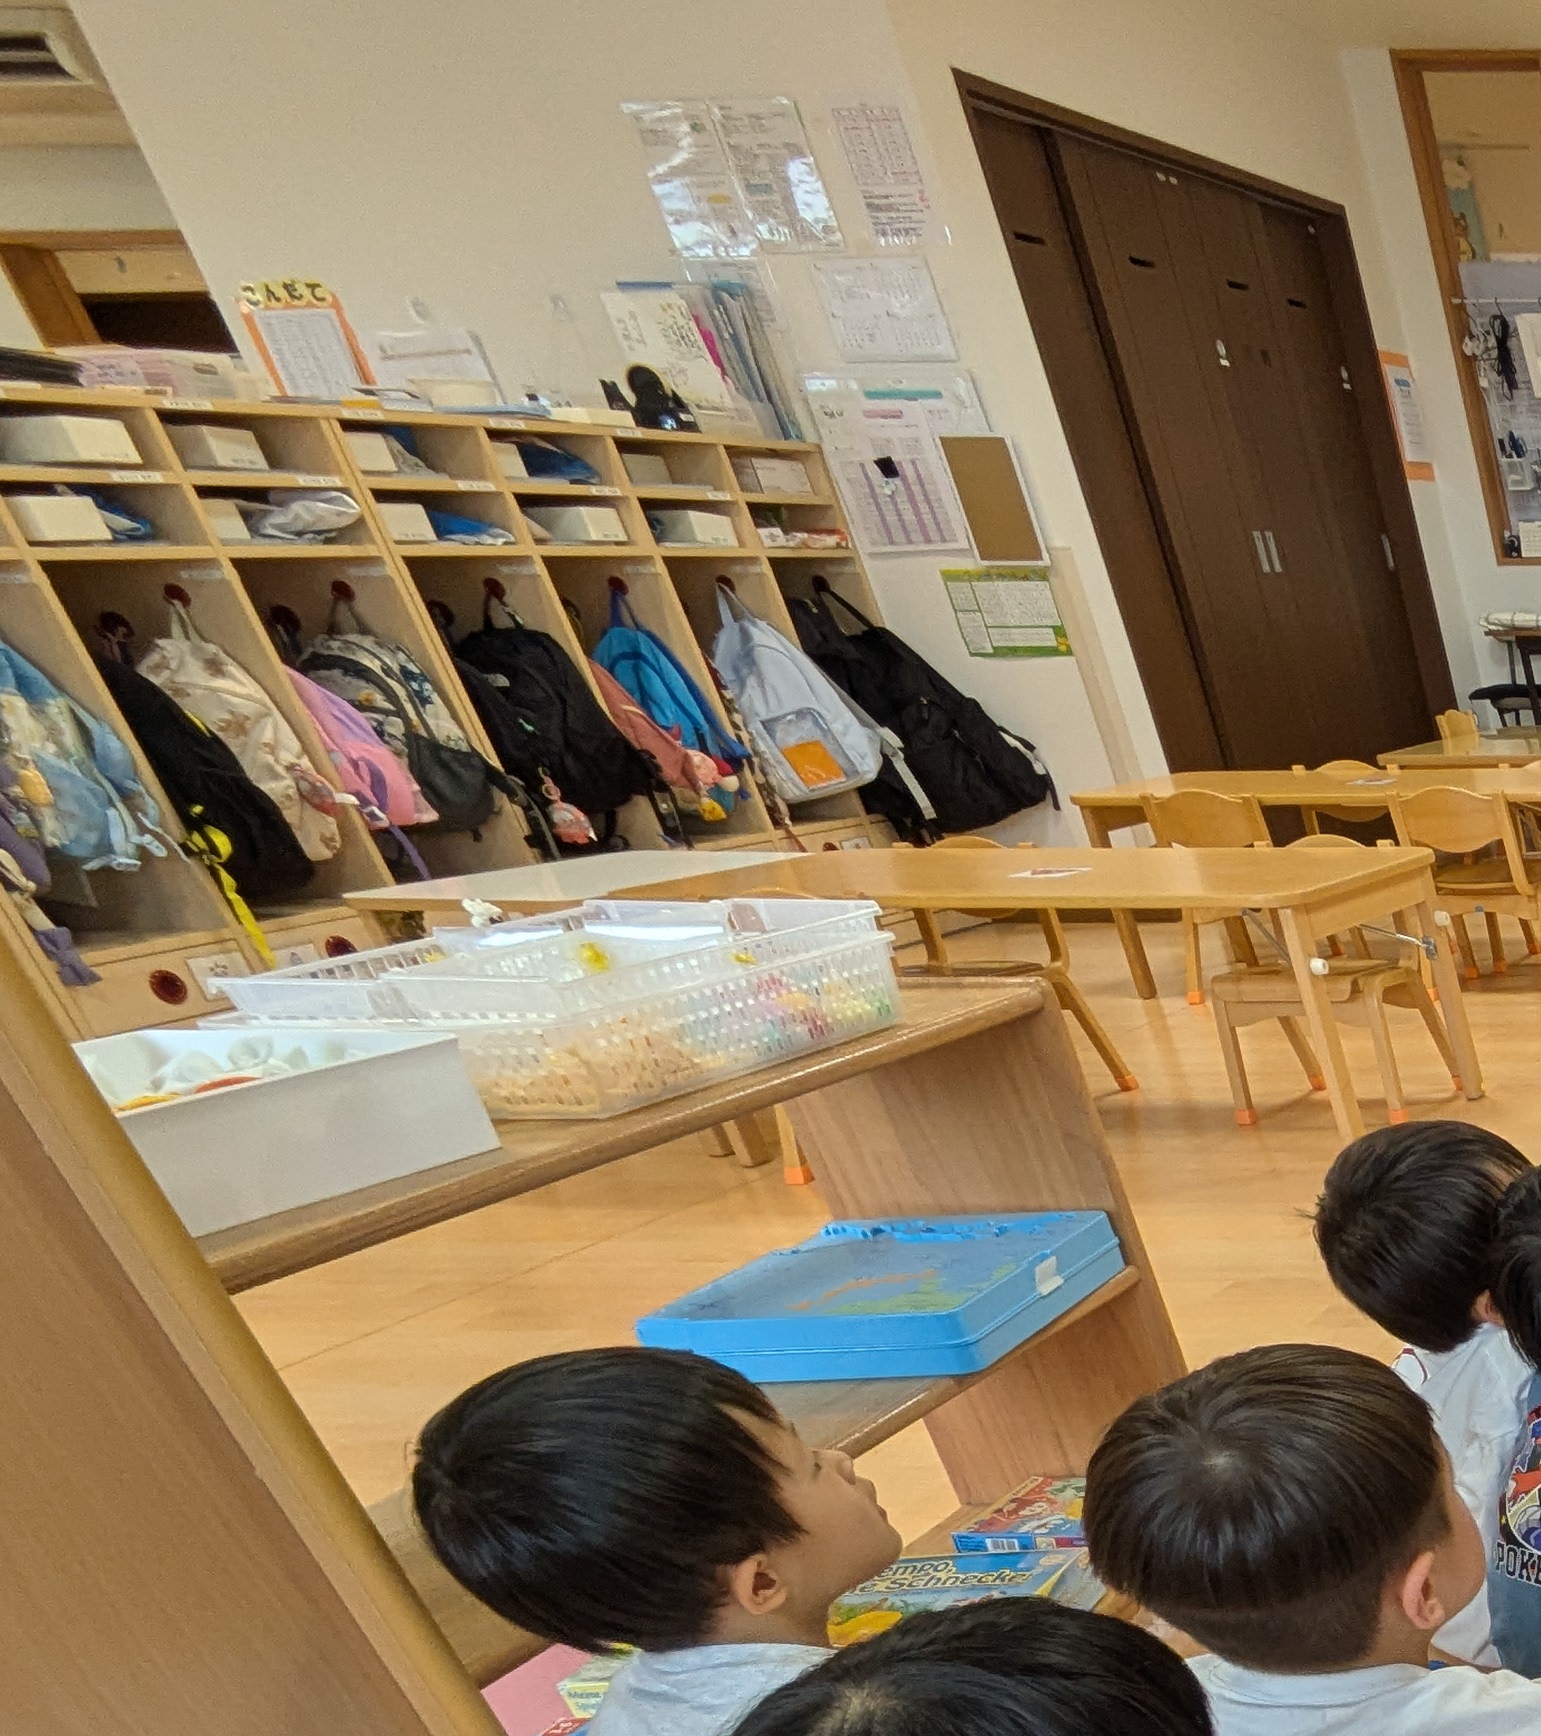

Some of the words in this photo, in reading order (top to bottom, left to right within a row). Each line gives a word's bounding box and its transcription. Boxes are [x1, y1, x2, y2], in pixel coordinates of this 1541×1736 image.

[241, 280, 327, 307] こんだて
[877, 1560, 957, 1579] empo,
